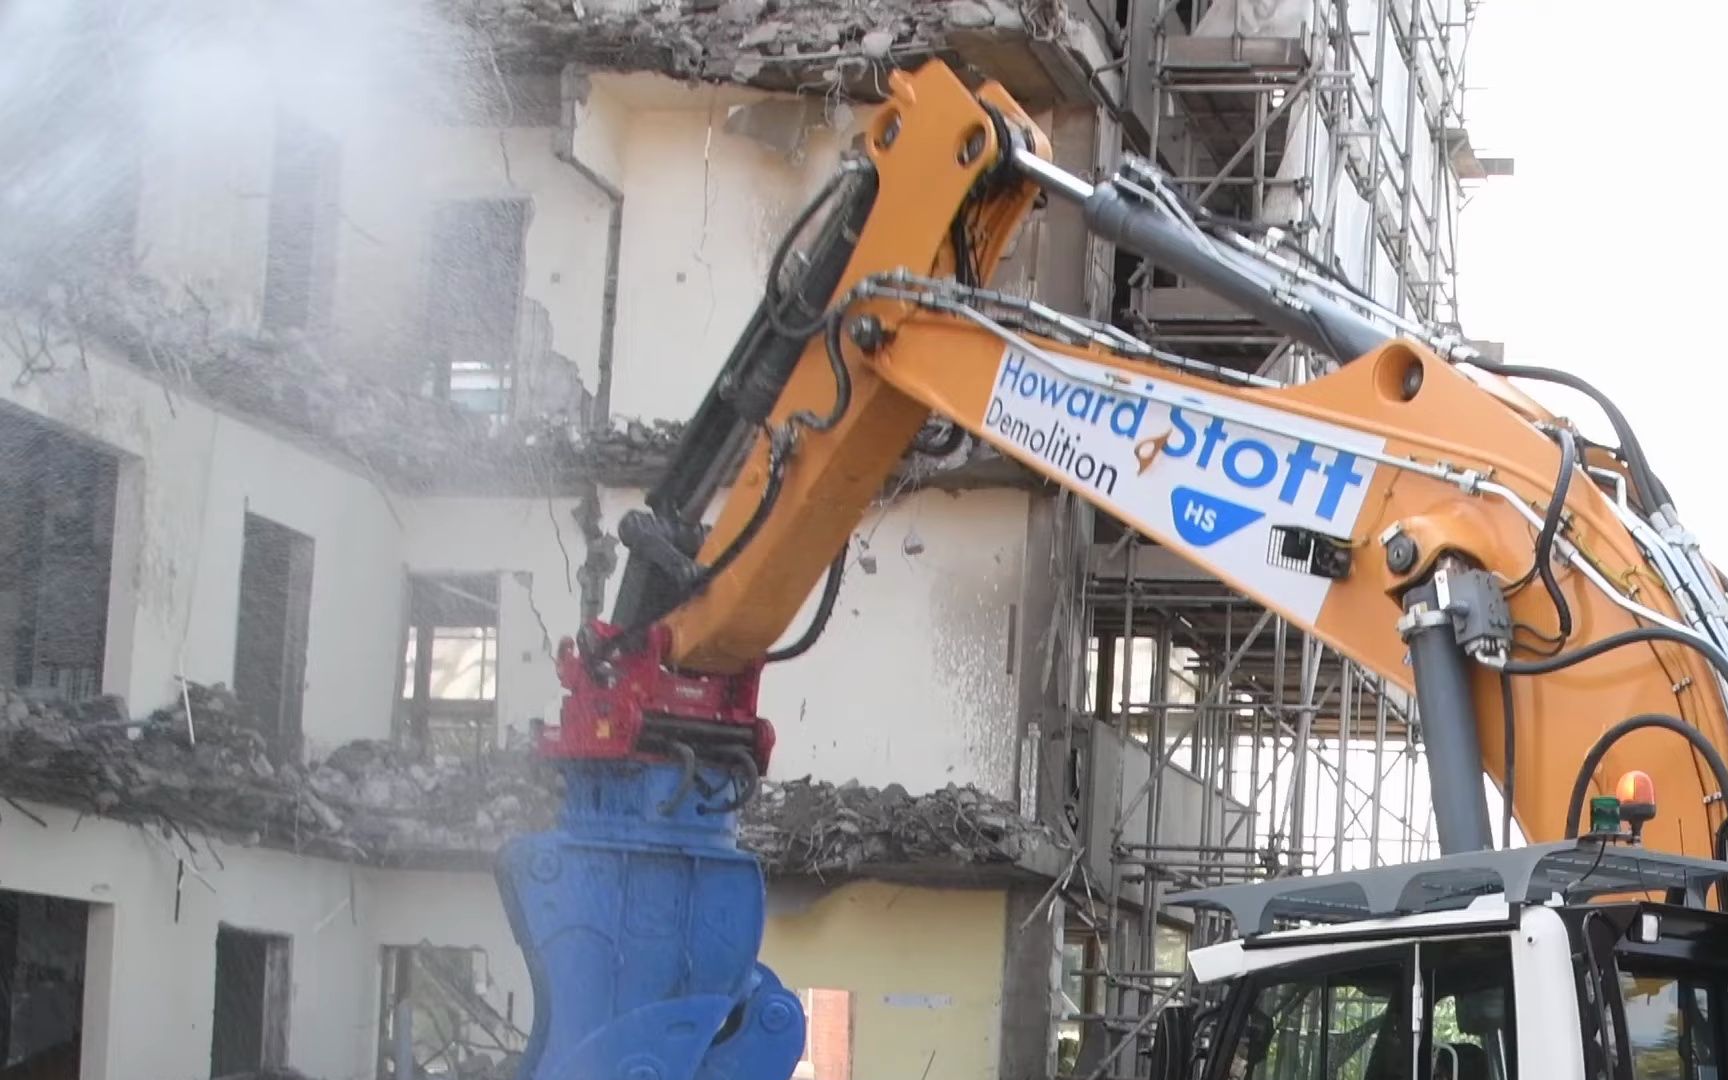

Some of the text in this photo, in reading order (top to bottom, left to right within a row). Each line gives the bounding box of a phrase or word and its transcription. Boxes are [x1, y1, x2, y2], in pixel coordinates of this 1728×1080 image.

[985, 395, 1119, 496] Demolition
[999, 352, 1364, 522] Howard Stott
[1184, 499, 1217, 534] HS
